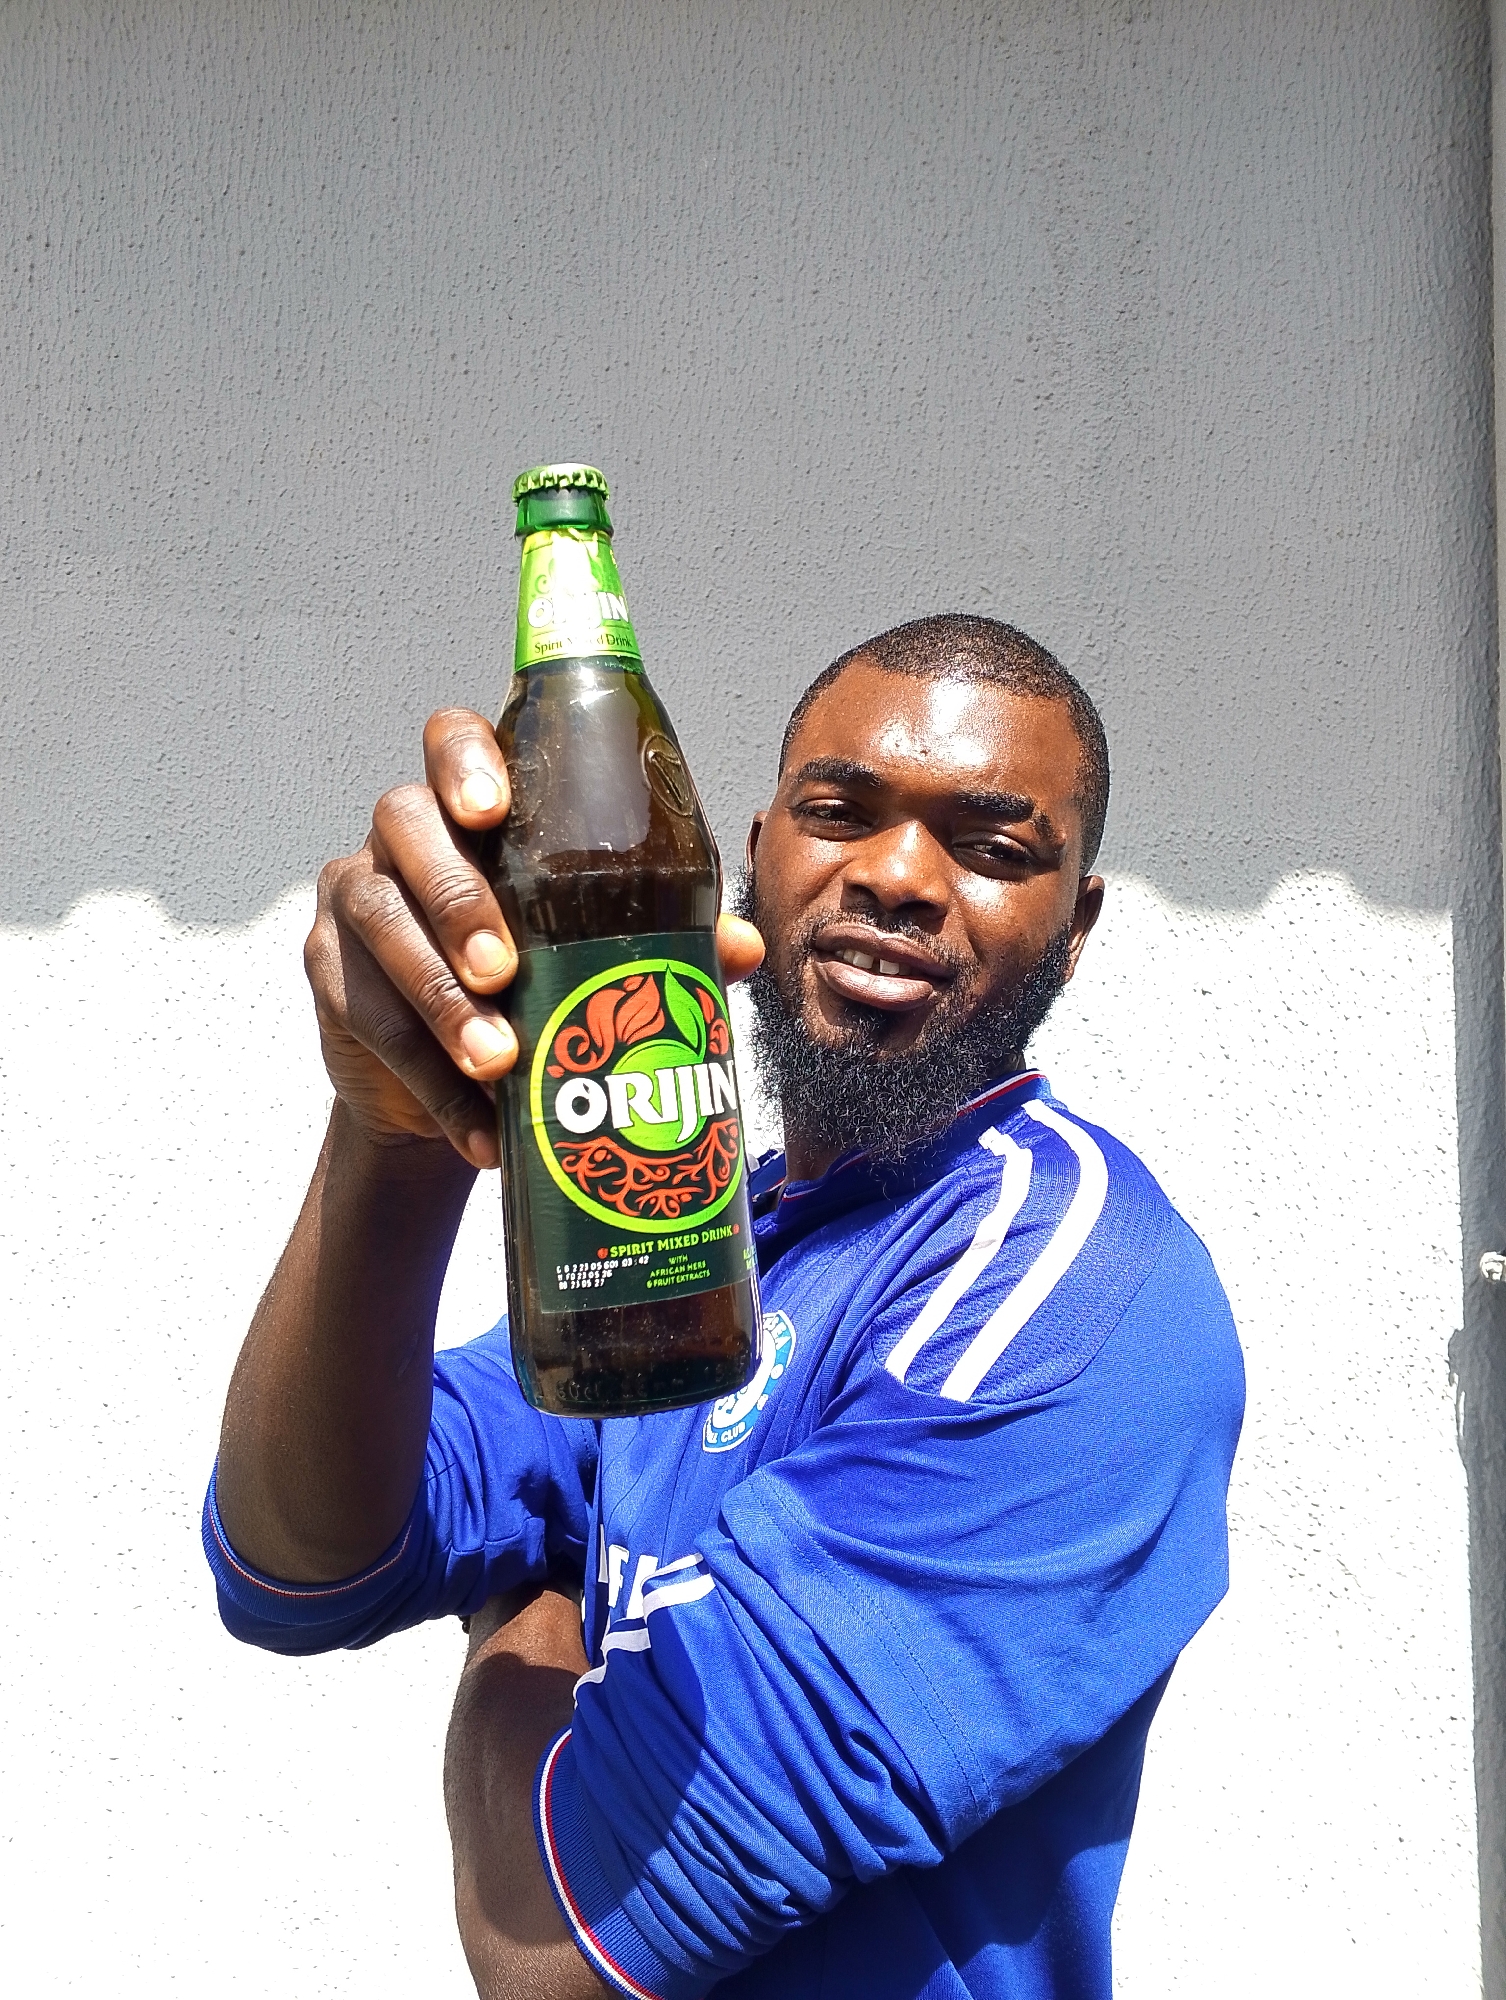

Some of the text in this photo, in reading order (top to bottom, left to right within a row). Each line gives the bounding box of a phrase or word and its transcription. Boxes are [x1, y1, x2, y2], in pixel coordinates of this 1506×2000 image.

[534, 638, 563, 655] Spirit
[606, 633, 633, 648] Drink
[554, 1059, 738, 1143] ORIJIN
[610, 1225, 733, 1258] SPIRIT MIXED DRINK
[668, 1254, 688, 1265] WITH
[650, 1265, 685, 1278] AFRICAN
[653, 1276, 675, 1288] FRUIT
[675, 1268, 711, 1284] EXTRACTS
[720, 1421, 746, 1444] CLUB
